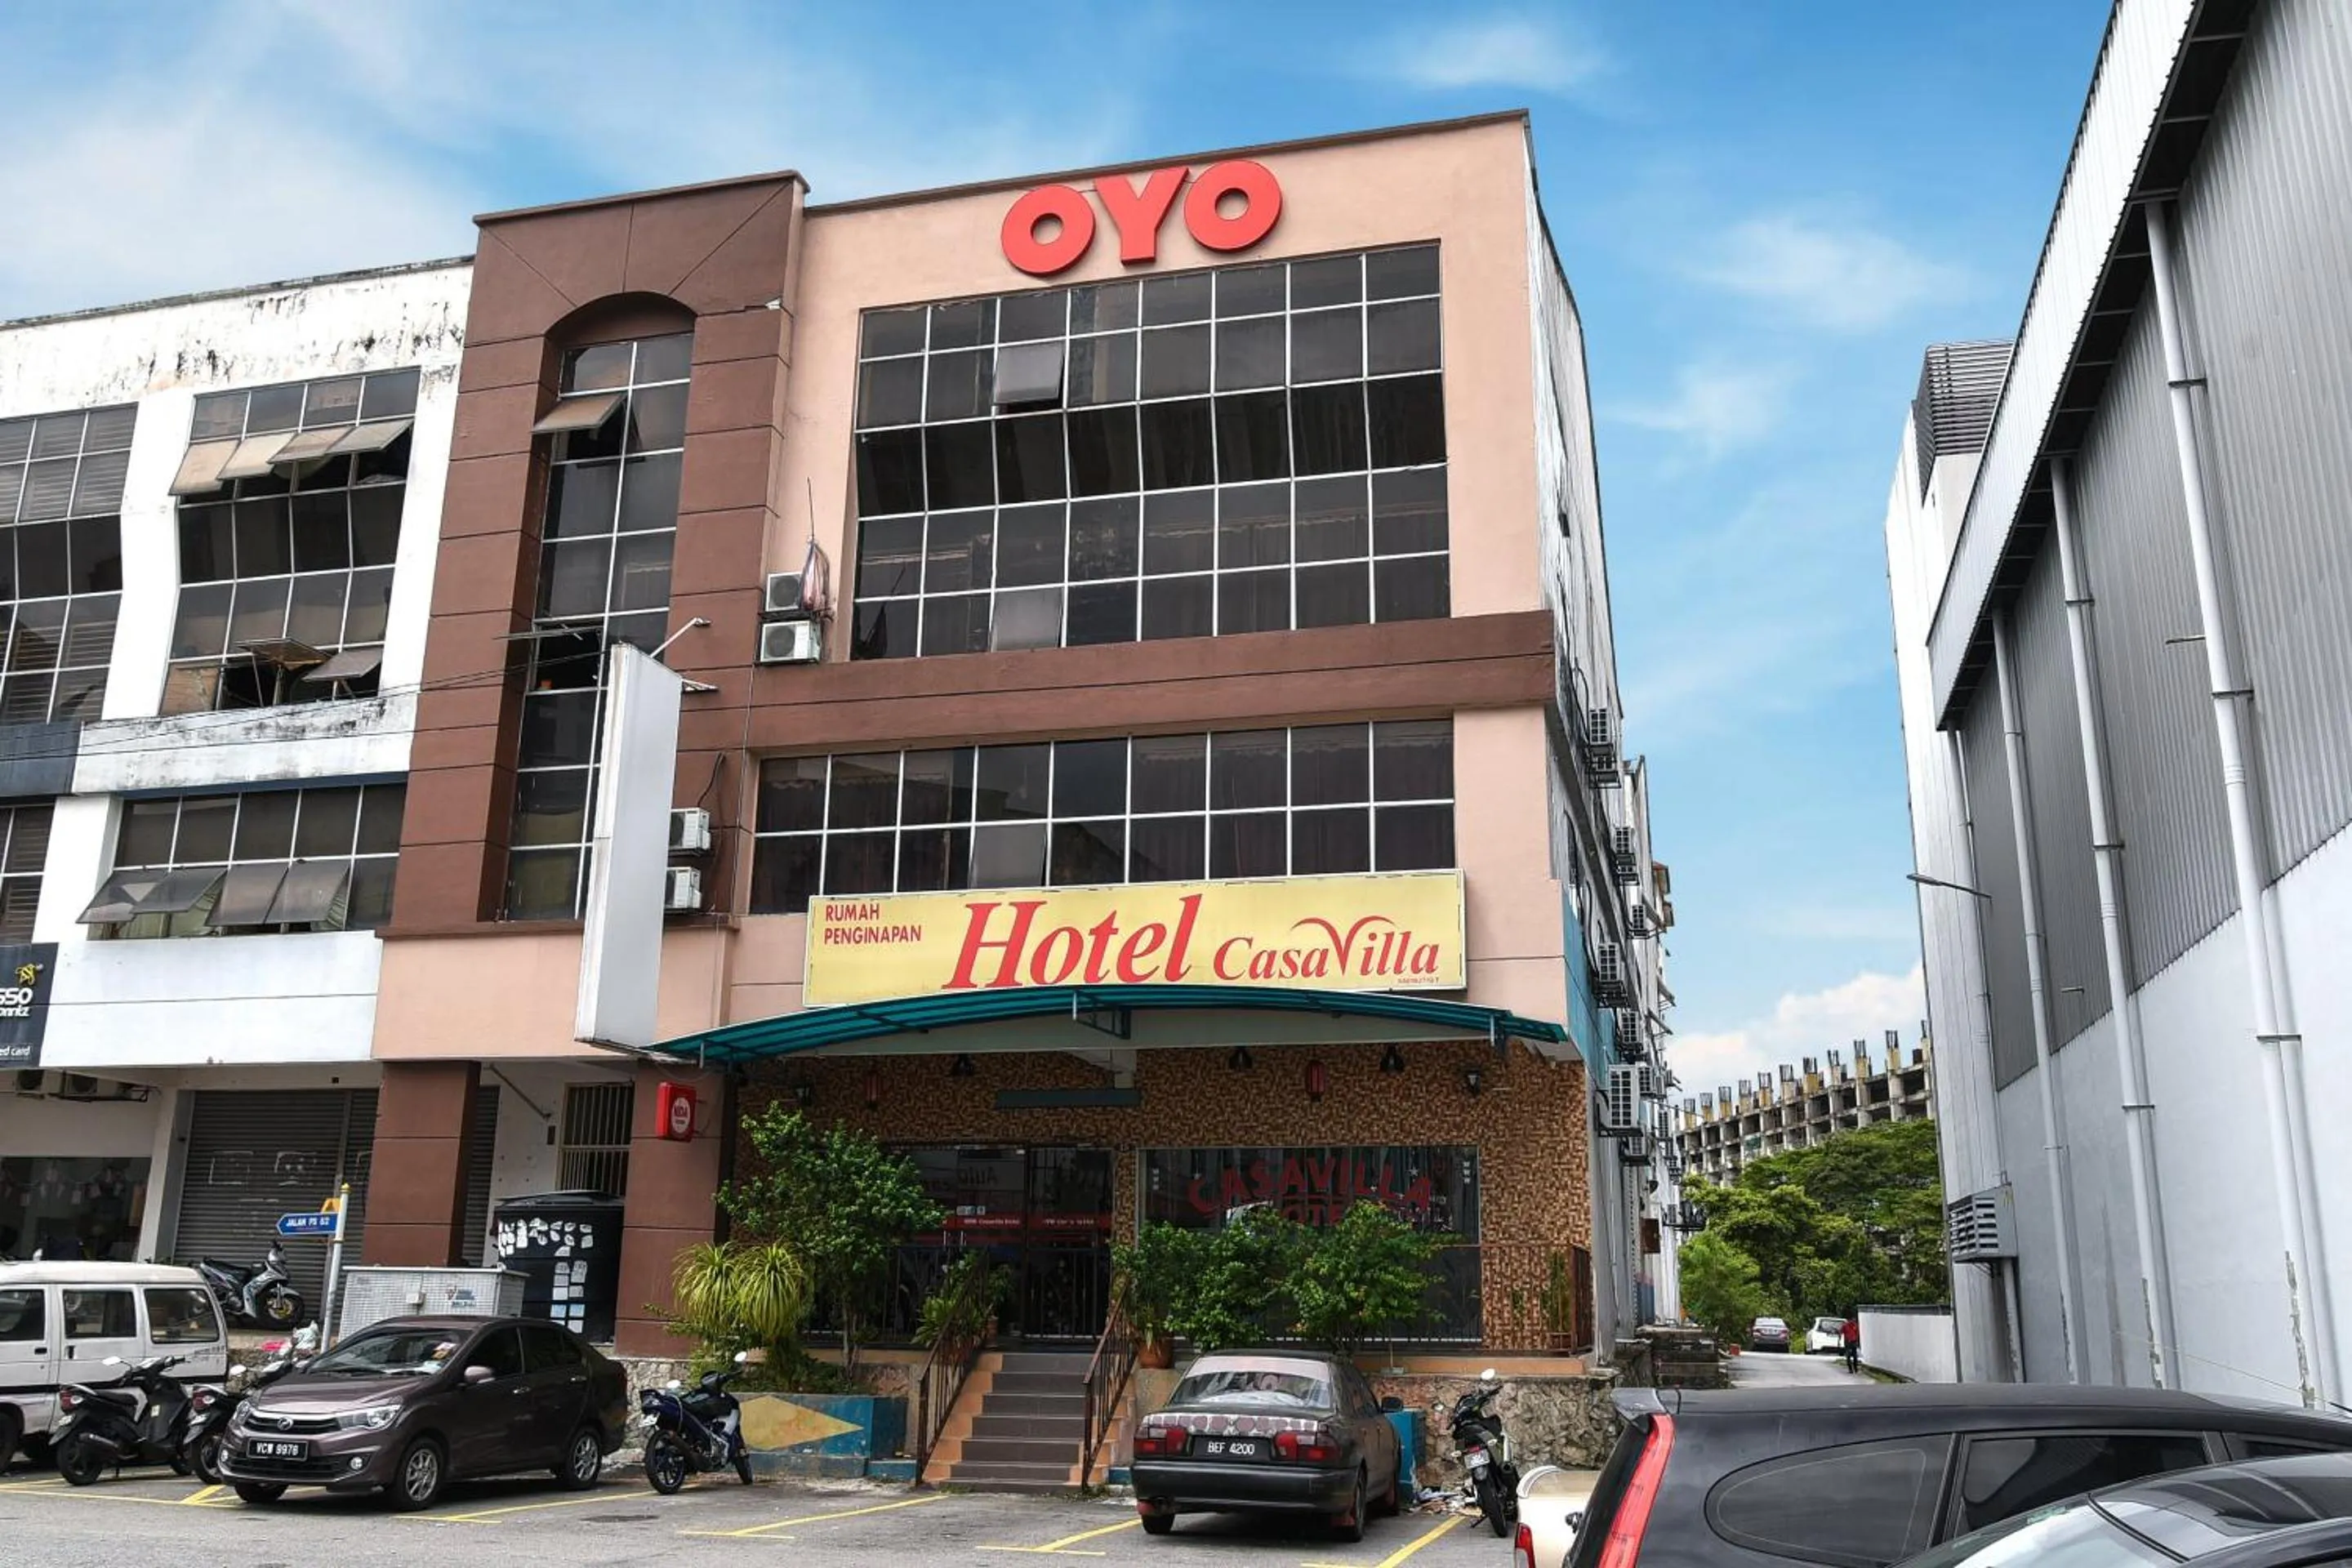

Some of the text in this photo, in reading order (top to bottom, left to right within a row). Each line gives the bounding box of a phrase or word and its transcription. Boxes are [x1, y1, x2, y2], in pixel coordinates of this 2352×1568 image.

[1001, 159, 1283, 277] OYO
[826, 903, 880, 922] RUMAH
[824, 924, 922, 945] PENGINAPAN
[941, 893, 1440, 989] Hotel CasaVilla
[1187, 1155, 1432, 1215] CASAVILLA
[286, 1217, 307, 1227] JALAN
[1208, 1441, 1255, 1454] BEF 4200
